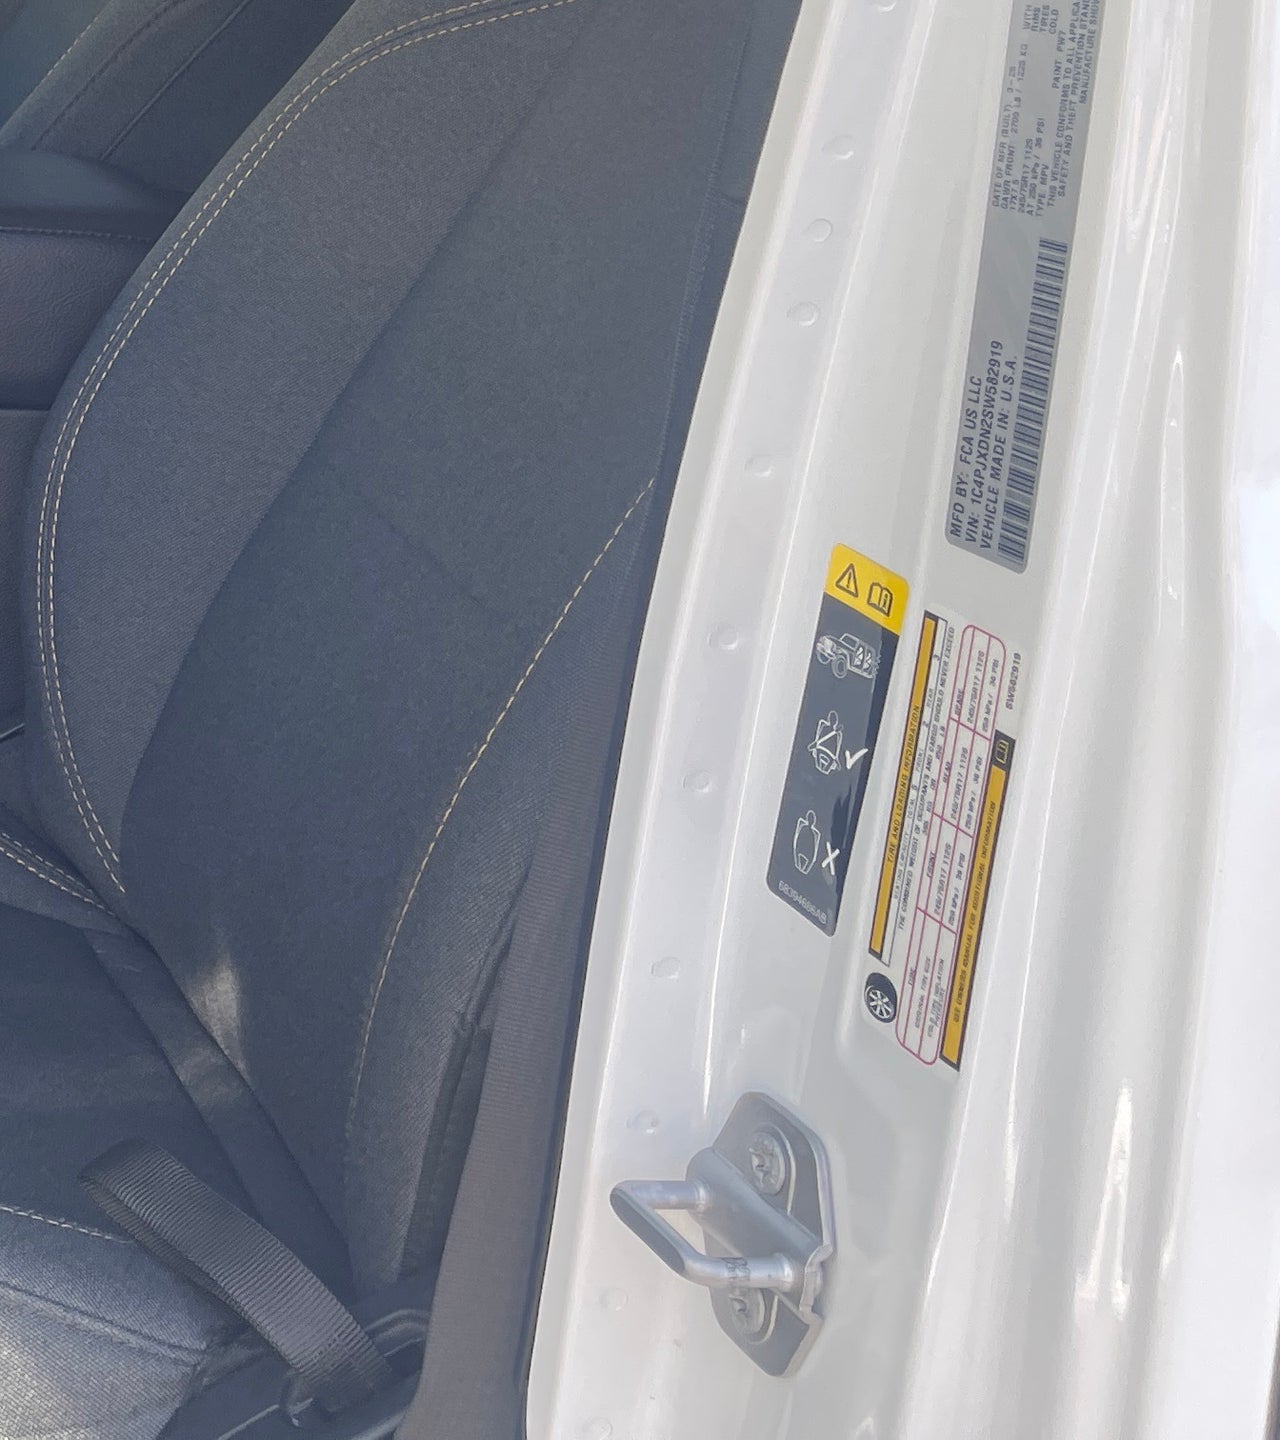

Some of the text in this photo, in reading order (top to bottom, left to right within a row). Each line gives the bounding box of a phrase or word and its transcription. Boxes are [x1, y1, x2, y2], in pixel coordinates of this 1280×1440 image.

[1022, 4, 1032, 30] WITH
[1030, 7, 1040, 31] RIMS
[1048, 8, 1059, 34] COLD
[1065, 46, 1074, 64] ALL
[1070, 33, 1085, 95] PREVENTION
[1078, 26, 1096, 103] MANUFACTURE
[1055, 82, 1070, 137] CONFORMS
[1066, 100, 1077, 130] THEFT
[1062, 134, 1073, 155] AND
[1039, 163, 1049, 185] MPV
[1050, 142, 1062, 181] VEHICLE
[1057, 159, 1069, 197] SAFETY
[1046, 185, 1057, 208] THIS
[966, 374, 982, 403] LLC
[996, 406, 1010, 430] IN:
[959, 434, 974, 464] FCA
[964, 339, 1002, 544] VIN: 1C4PJXDN2SW582919
[989, 433, 1006, 481] MADE
[954, 469, 969, 497] BY:
[949, 501, 965, 538] MFD
[979, 484, 999, 550] VEHICLE
[891, 817, 900, 840] AND
